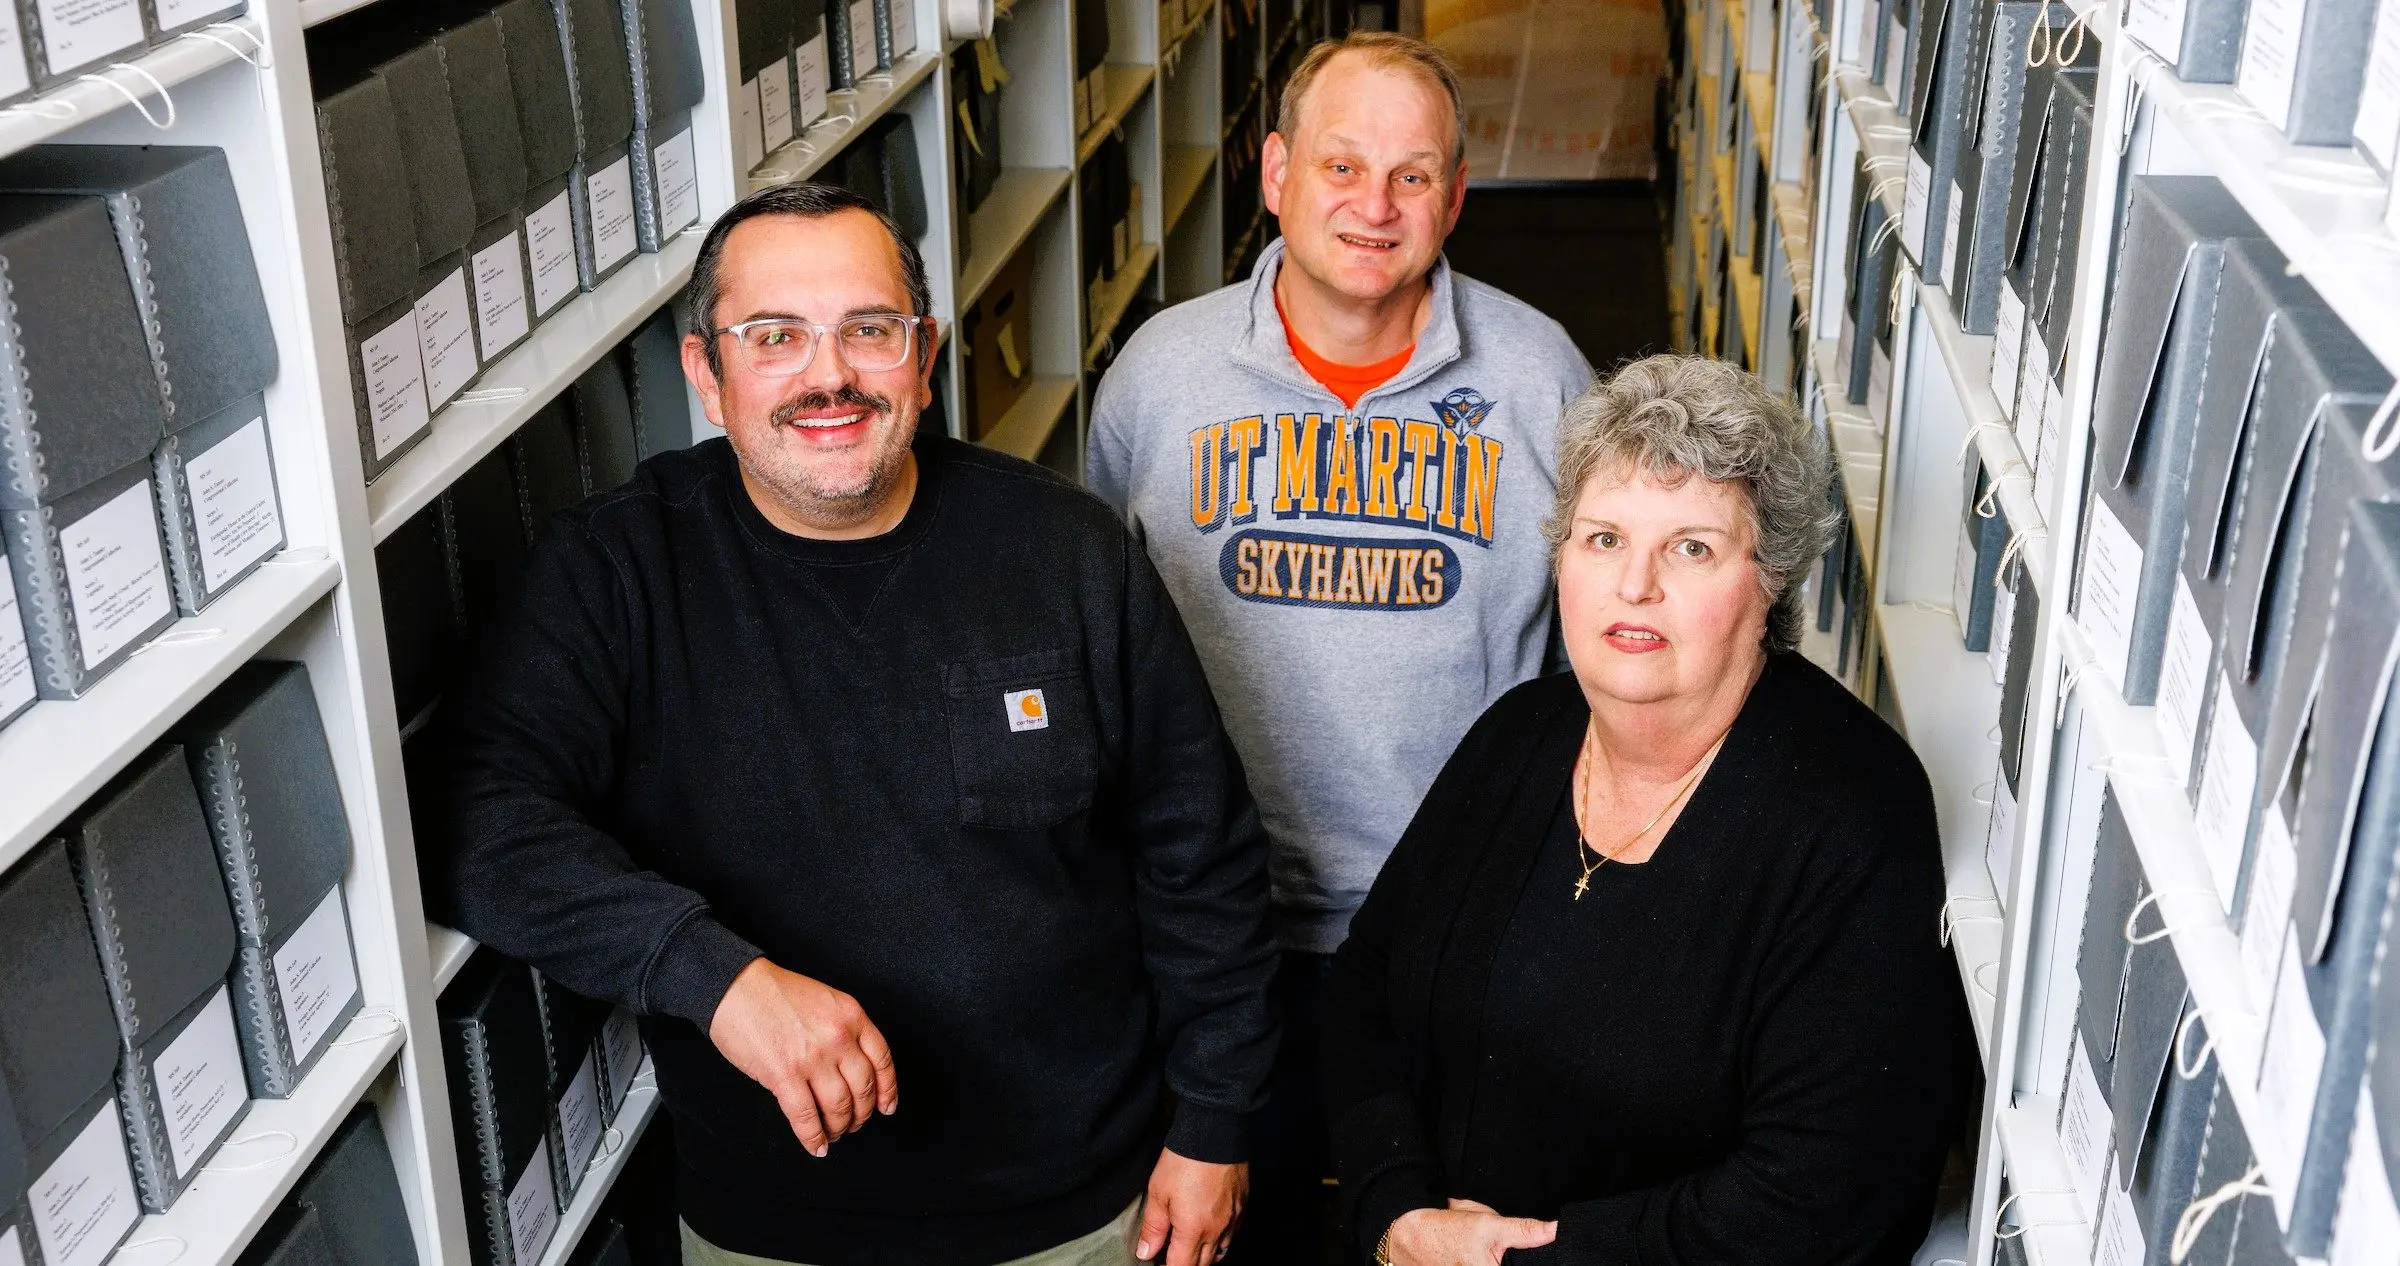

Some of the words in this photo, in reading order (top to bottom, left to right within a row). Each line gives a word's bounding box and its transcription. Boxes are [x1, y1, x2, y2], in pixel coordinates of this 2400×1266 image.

[1188, 414, 1267, 535] UT
[1273, 413, 1504, 549] MARTIN
[1236, 538, 1444, 605] SKYHAWKS
